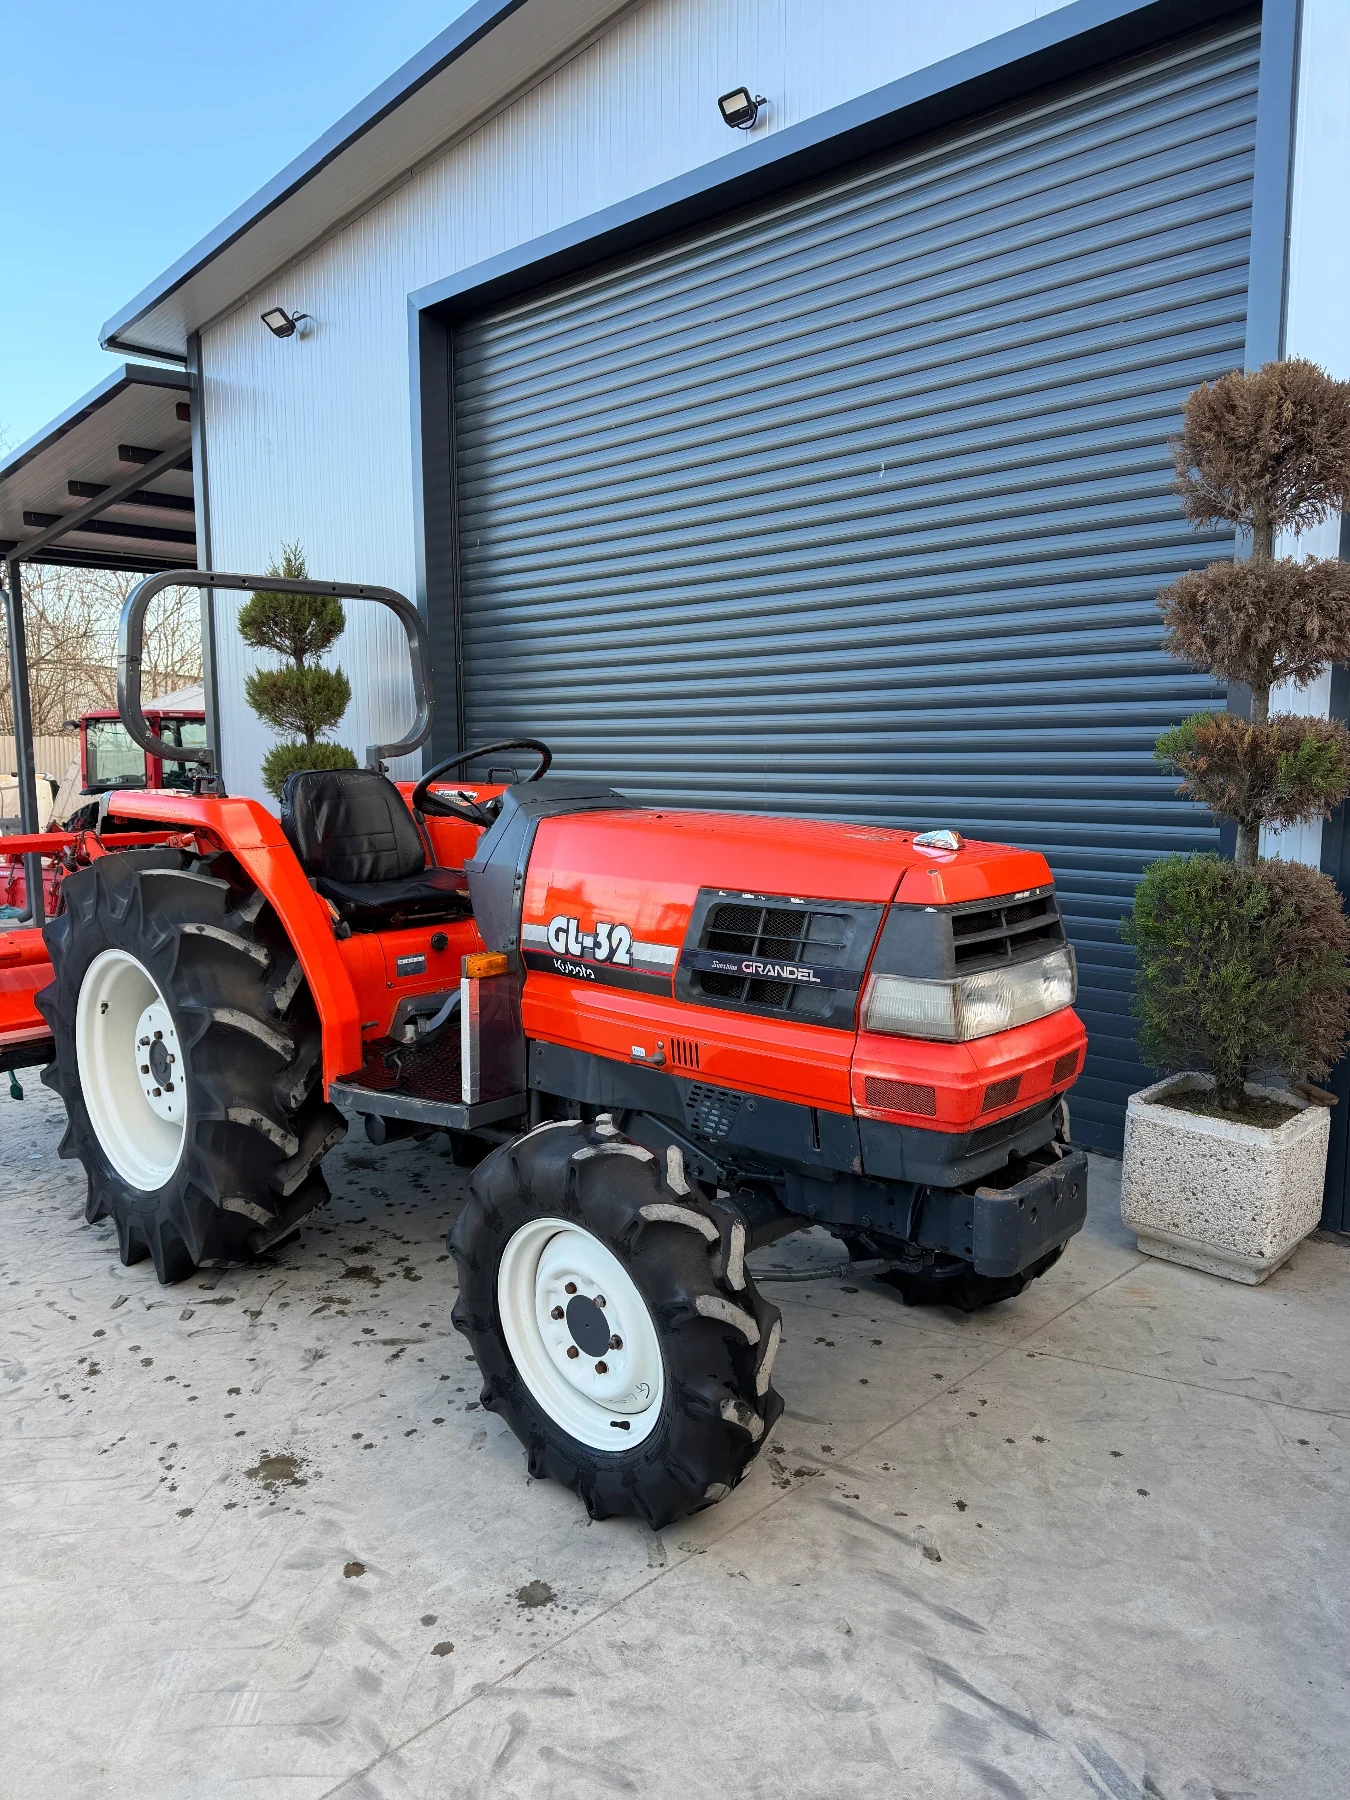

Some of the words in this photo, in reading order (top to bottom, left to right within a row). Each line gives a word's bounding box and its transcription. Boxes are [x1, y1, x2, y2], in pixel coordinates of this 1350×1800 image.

[547, 914, 632, 967] GL-32
[553, 958, 596, 979] Kubota
[741, 961, 821, 983] GRANDEL
